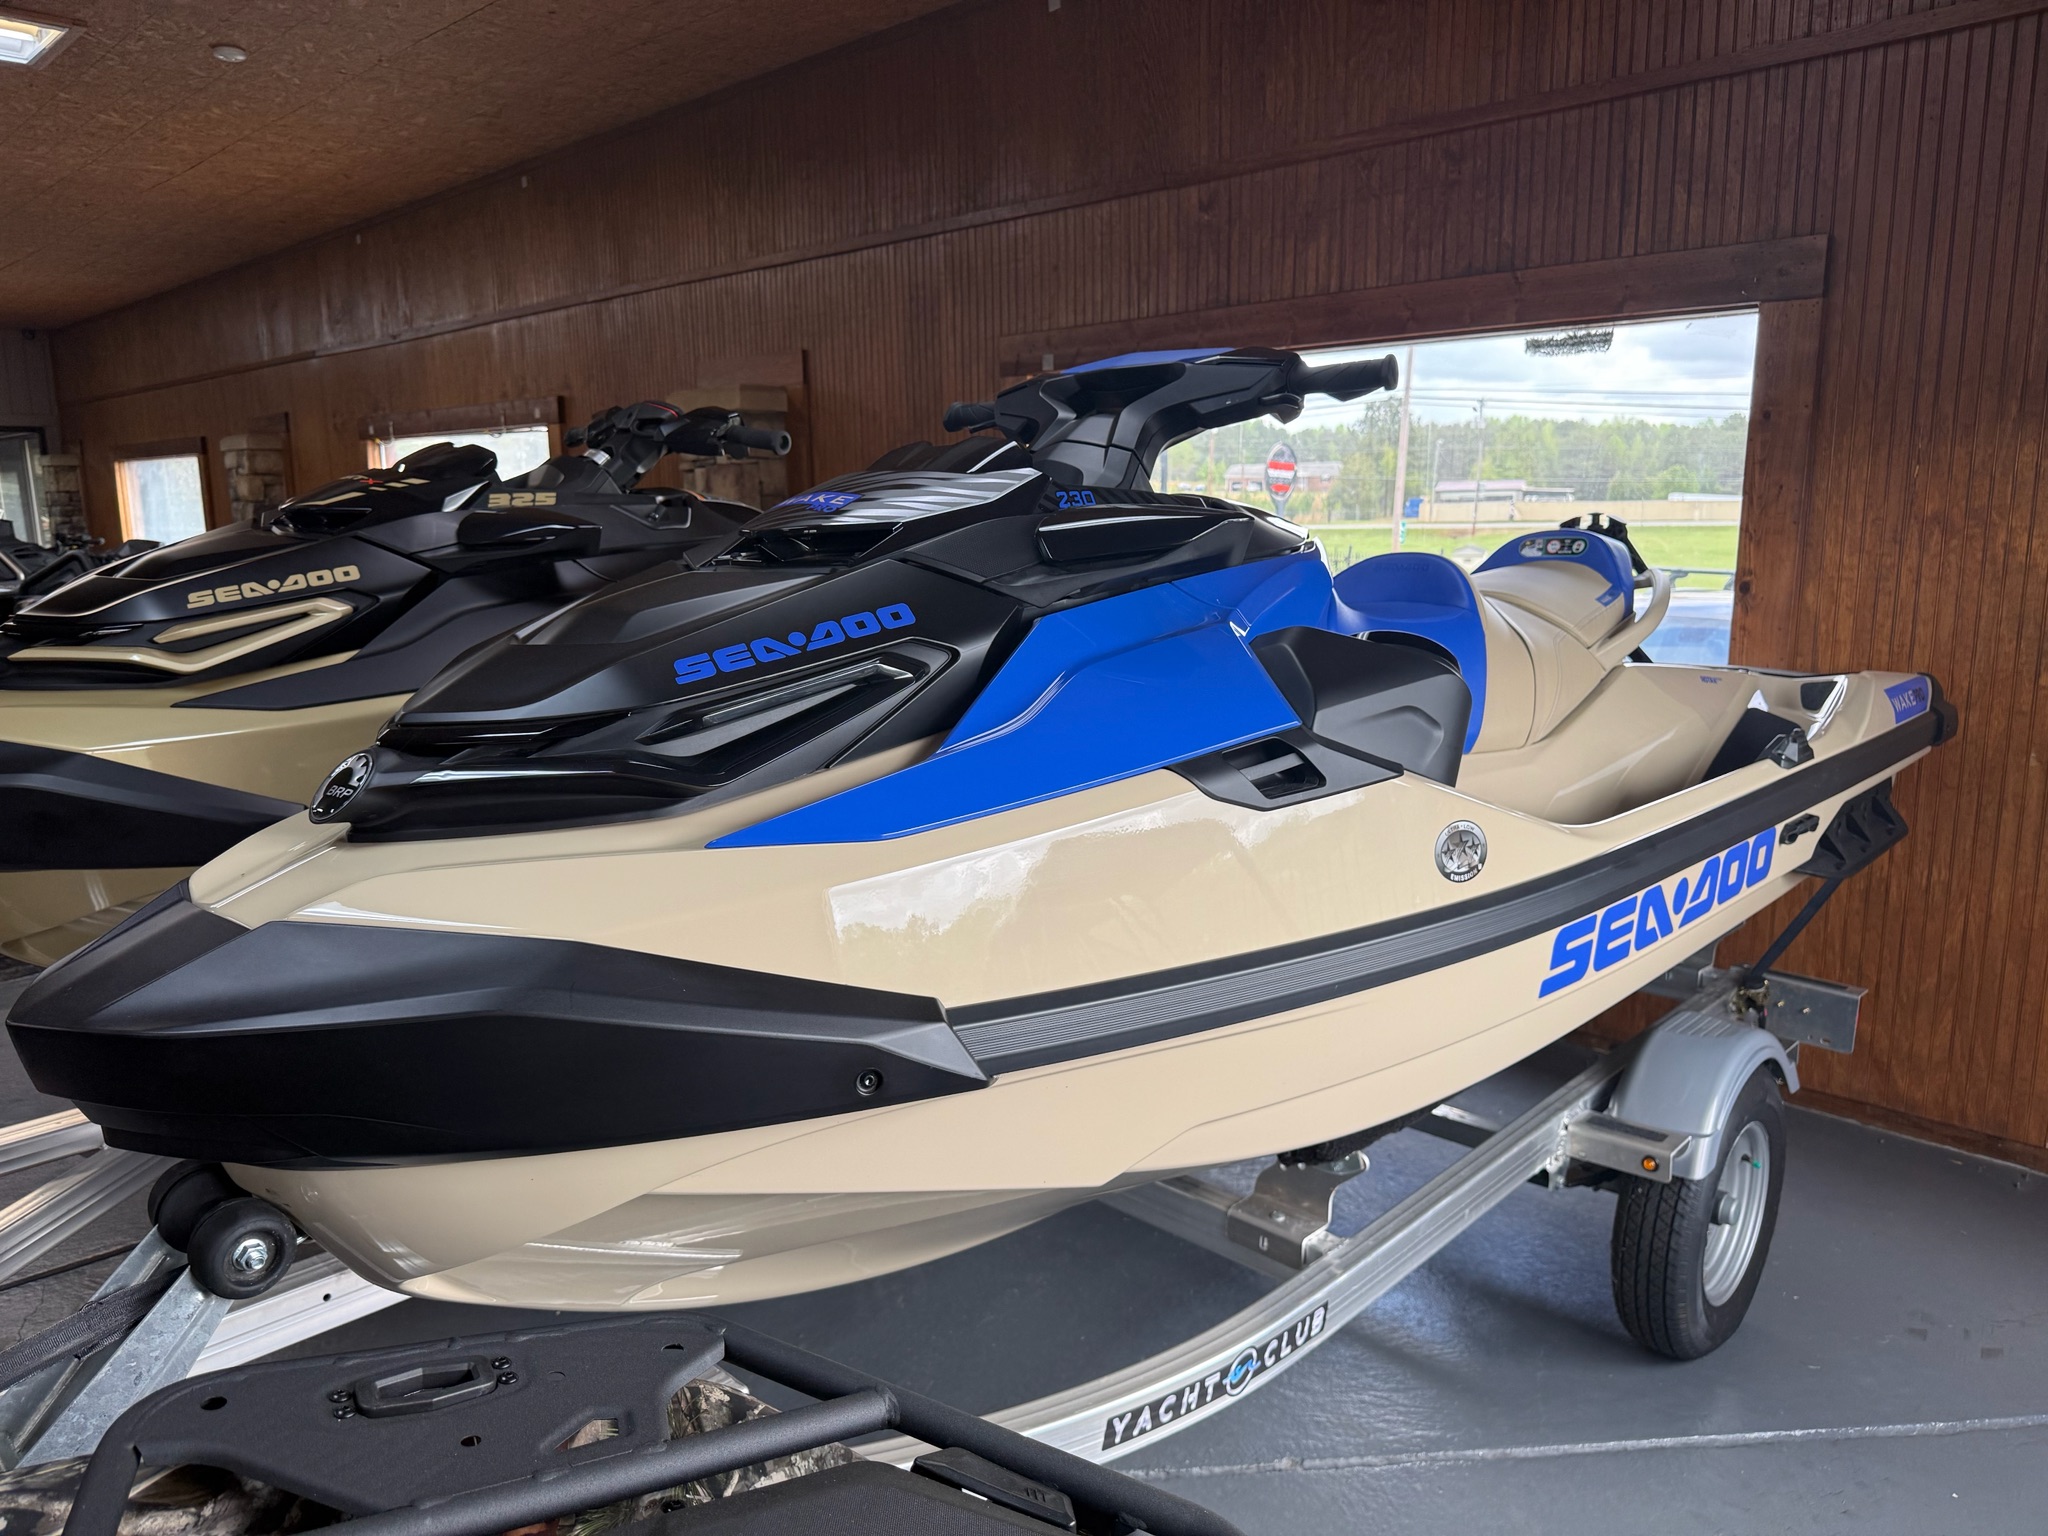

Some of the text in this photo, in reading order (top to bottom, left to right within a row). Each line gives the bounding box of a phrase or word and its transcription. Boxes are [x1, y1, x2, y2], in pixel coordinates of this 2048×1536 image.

[488, 492, 557, 508] 325
[1056, 490, 1096, 509] 230
[326, 784, 354, 798] BRP
[1450, 867, 1478, 881] EMISSION
[1112, 1306, 1326, 1444] YACHT CLUB
